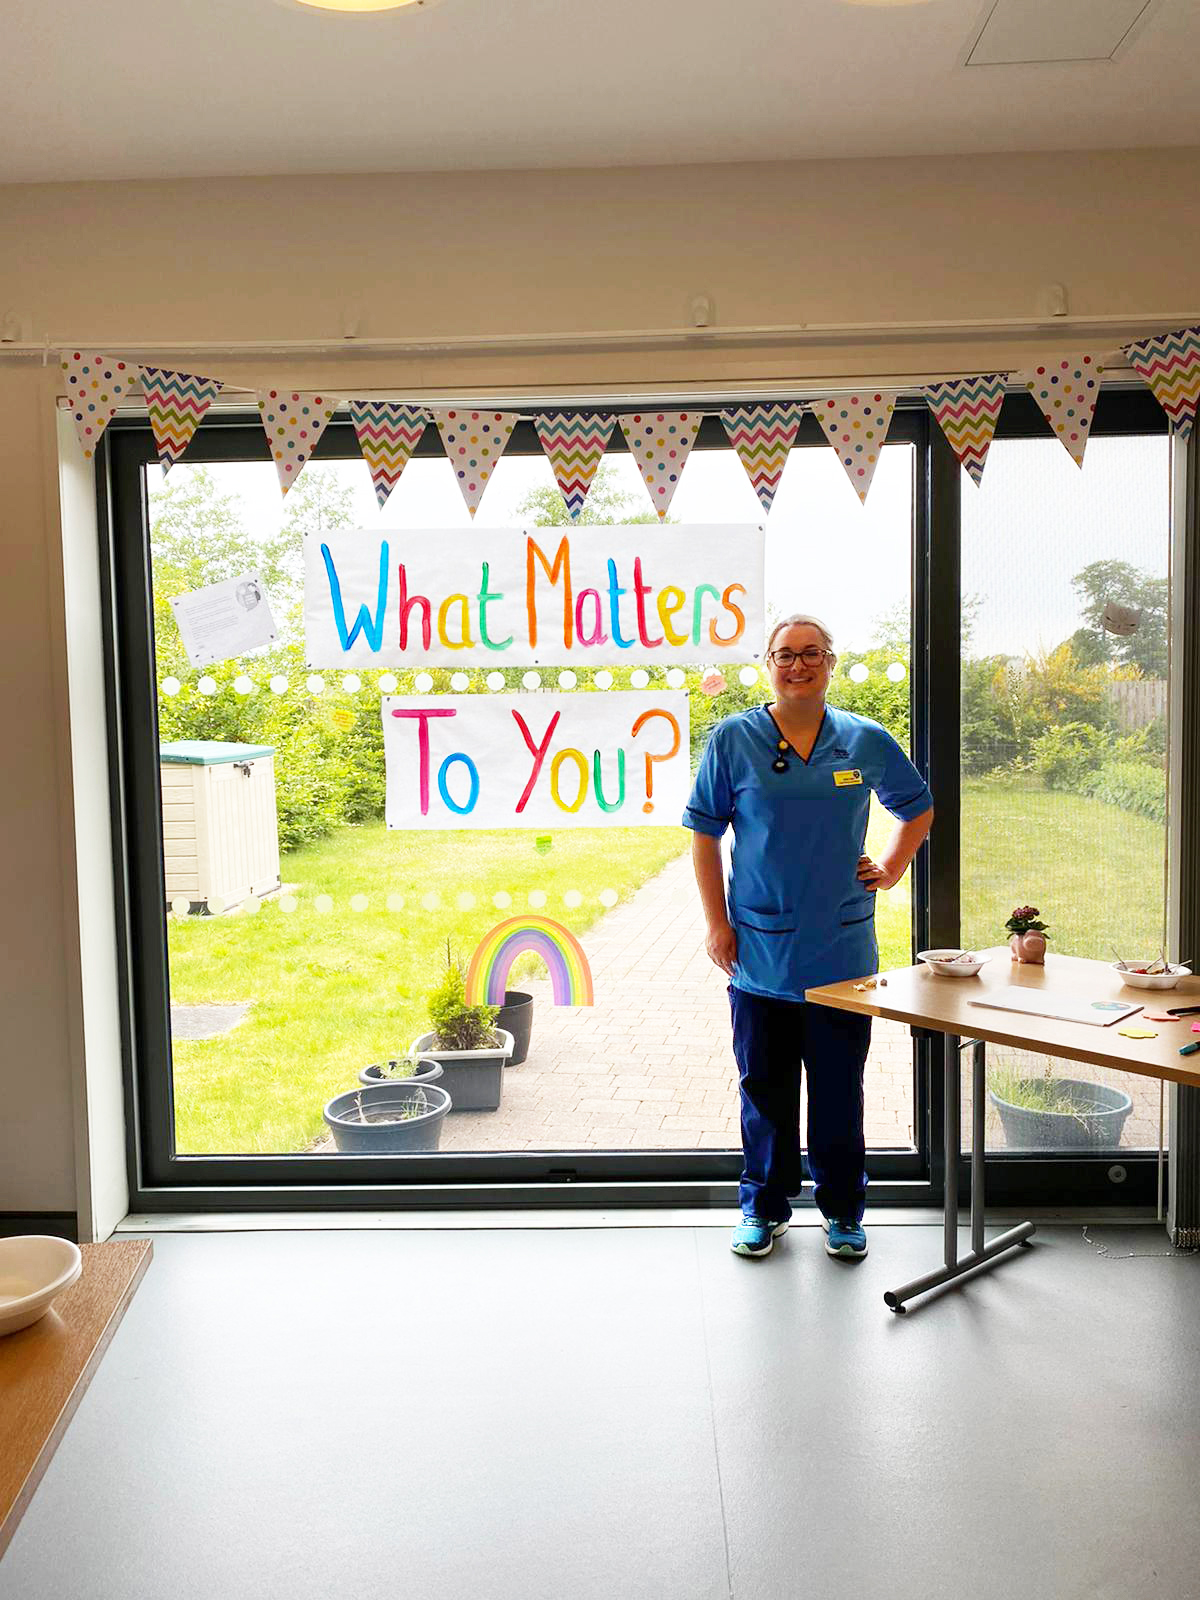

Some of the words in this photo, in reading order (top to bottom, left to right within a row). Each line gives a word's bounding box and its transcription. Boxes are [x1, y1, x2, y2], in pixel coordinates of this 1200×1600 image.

[321, 540, 513, 652] What
[526, 534, 747, 650] Matters
[391, 708, 480, 816] To
[511, 707, 682, 814] You?
